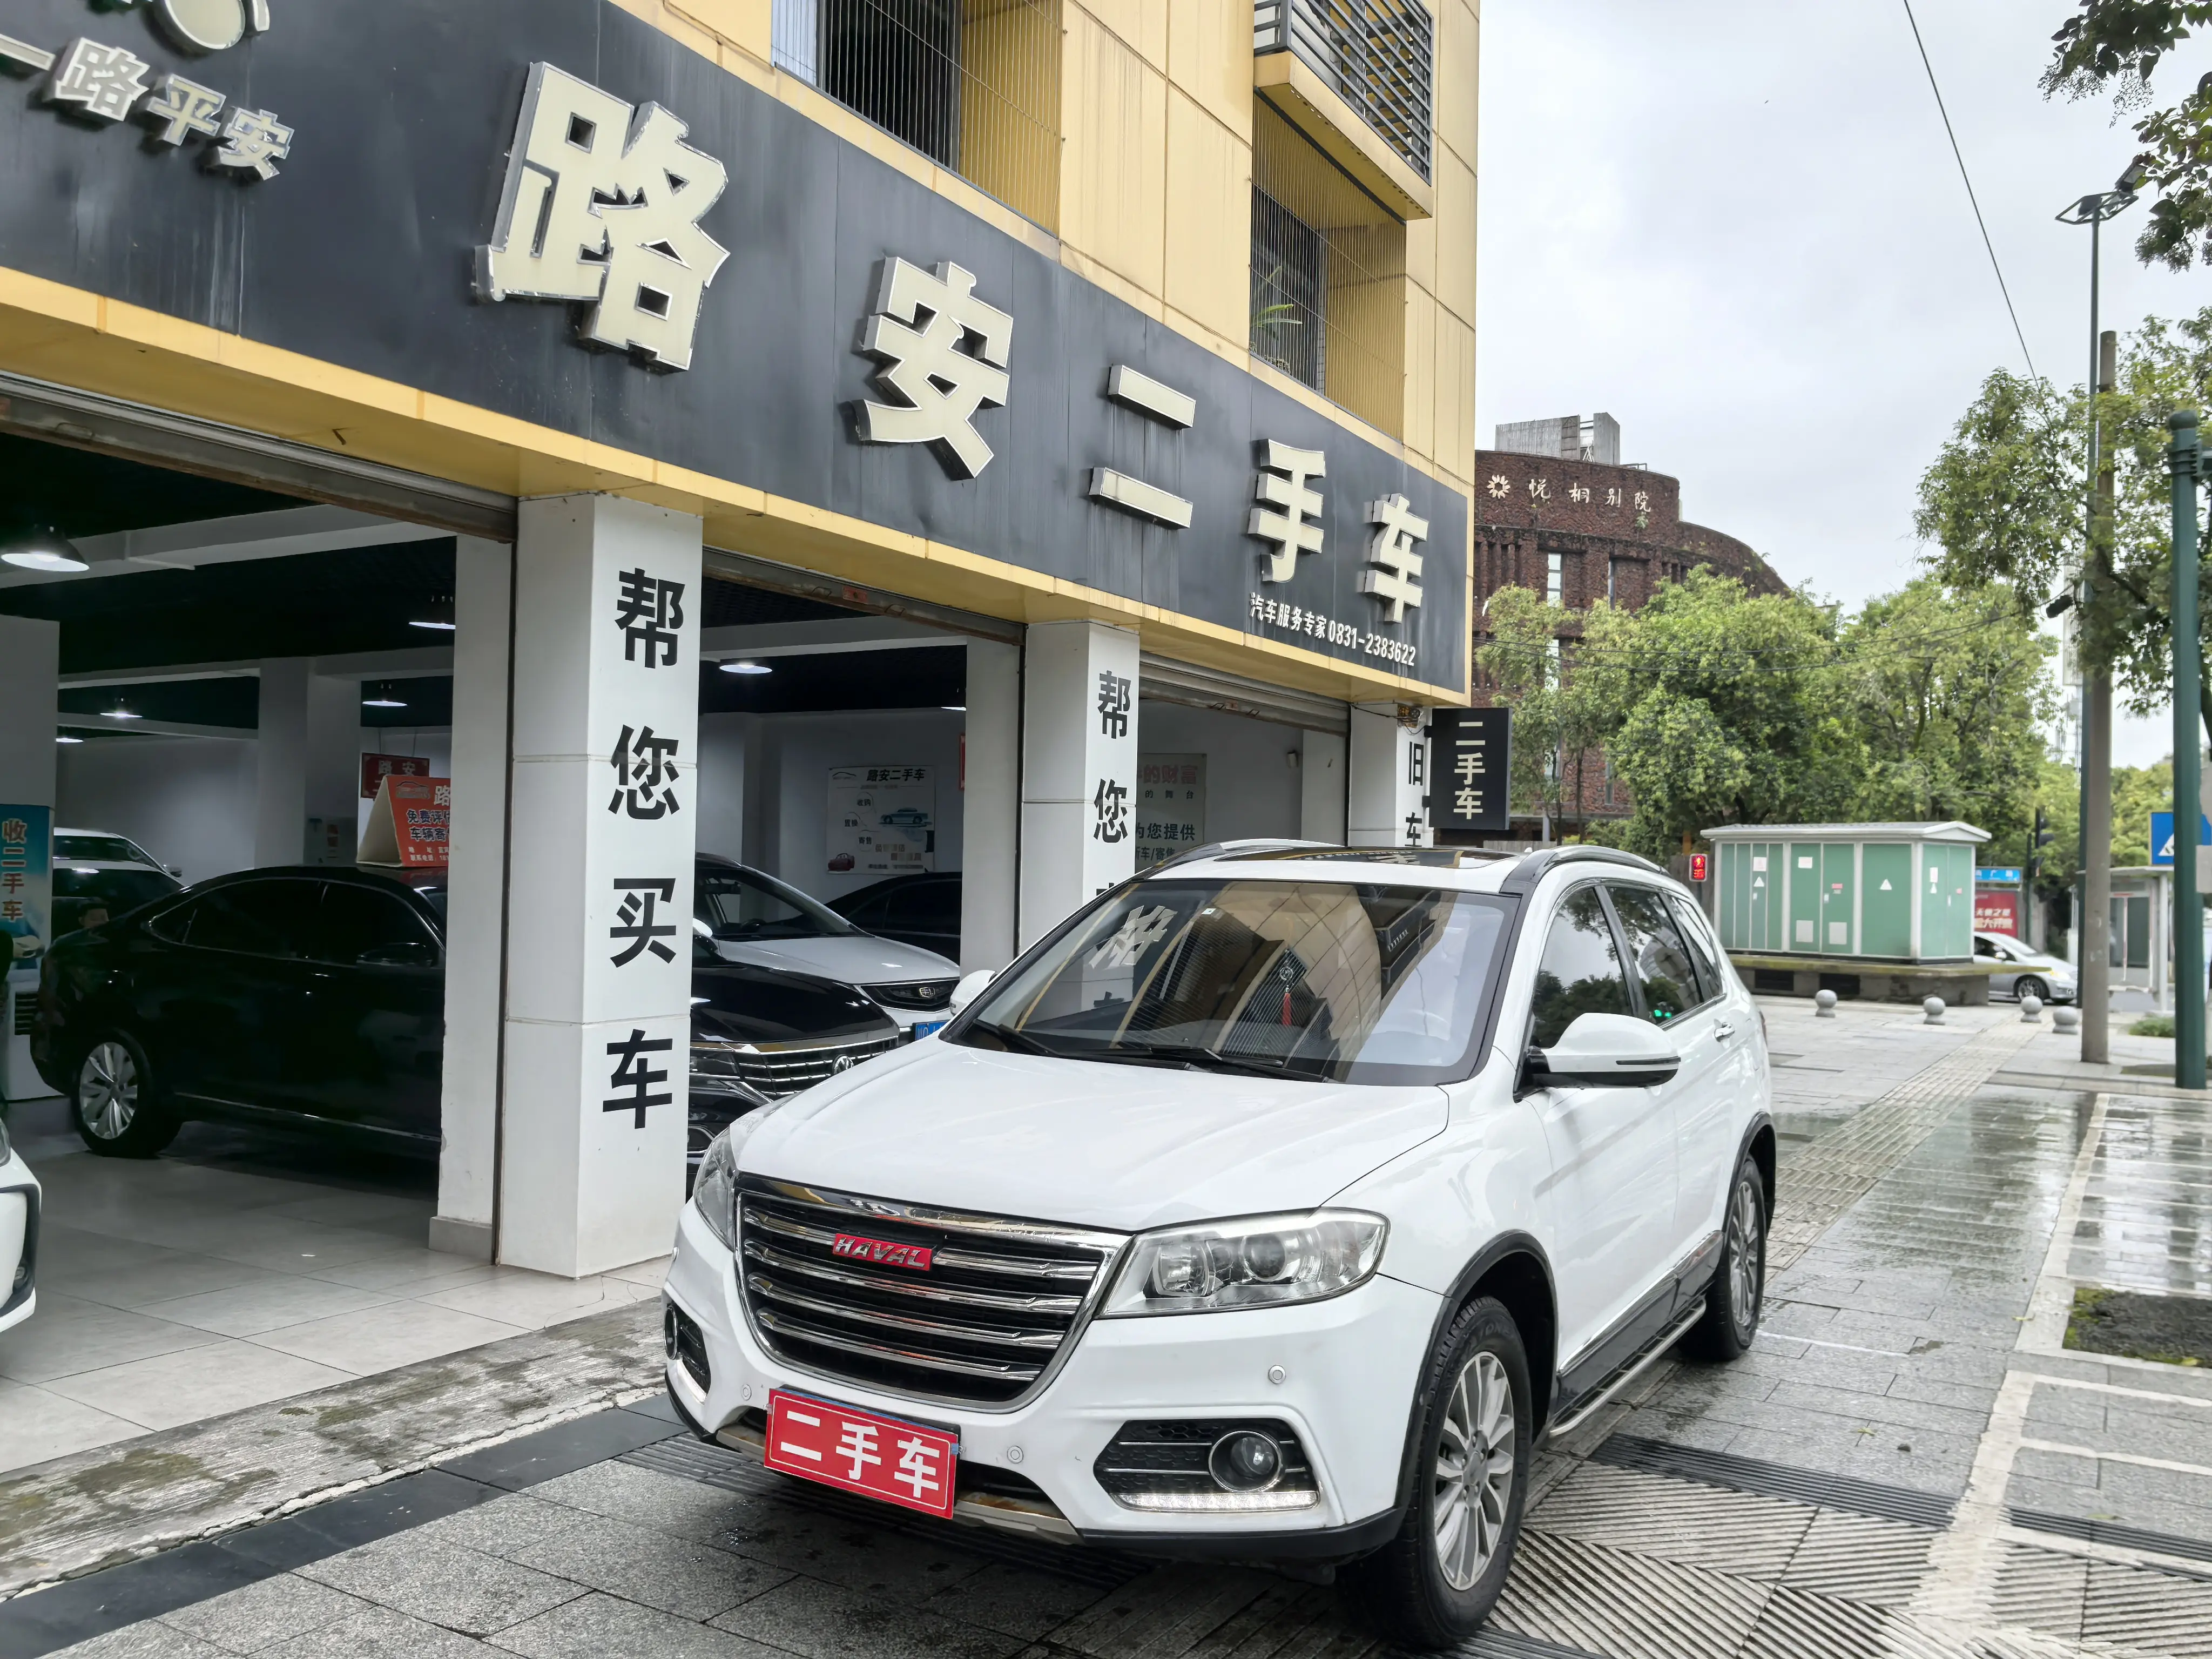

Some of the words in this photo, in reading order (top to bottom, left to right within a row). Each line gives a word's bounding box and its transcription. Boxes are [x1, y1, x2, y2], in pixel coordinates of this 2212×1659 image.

[473, 62, 1429, 623] 路安二手车
[1529, 478, 1651, 512] 悦桐别院
[1093, 670, 1131, 896] 帮您
[1138, 765, 1198, 784] 的财富
[1404, 741, 1424, 847] 旧车
[1454, 721, 1485, 820] 二手车
[2, 818, 27, 923] 收二手车
[409, 826, 449, 841] 车辆寄
[603, 568, 685, 1129] 帮您买车
[835, 1237, 925, 1267] HAVAL
[780, 1410, 940, 1498] 二手车
